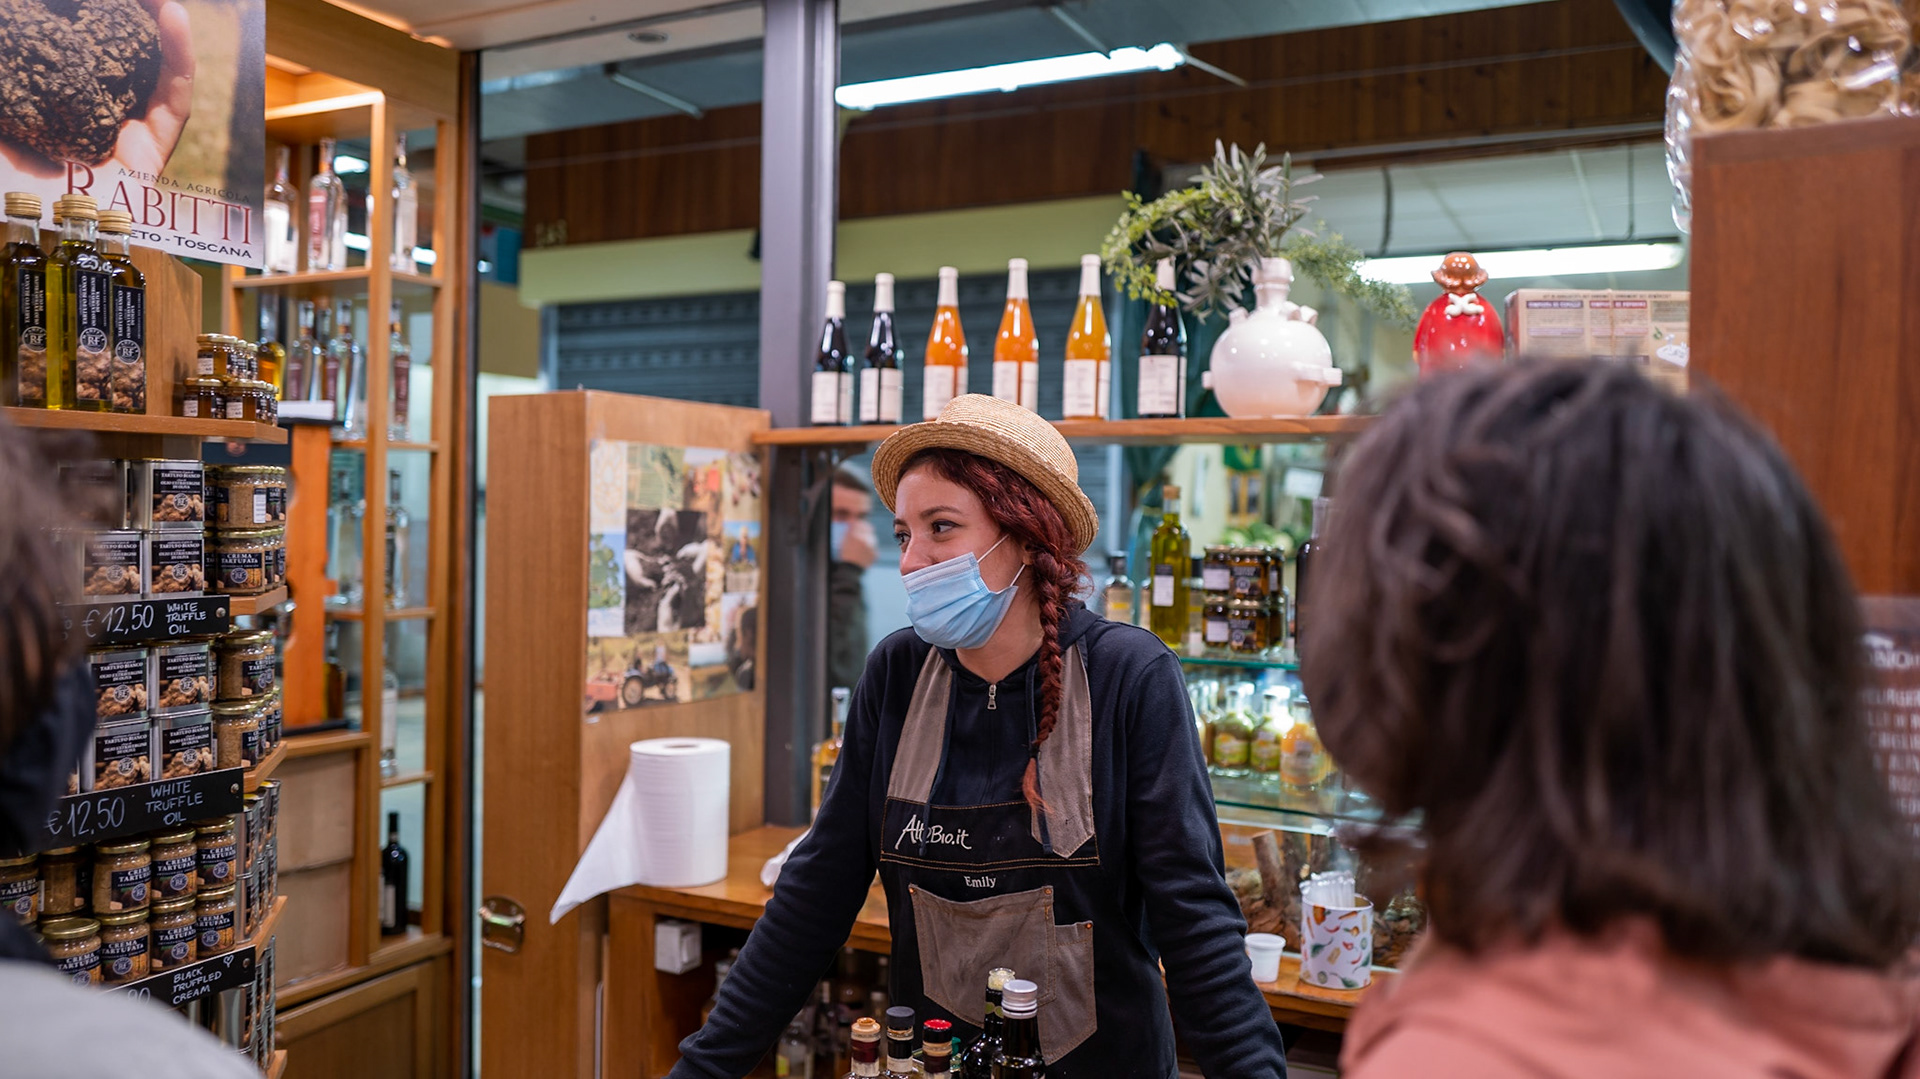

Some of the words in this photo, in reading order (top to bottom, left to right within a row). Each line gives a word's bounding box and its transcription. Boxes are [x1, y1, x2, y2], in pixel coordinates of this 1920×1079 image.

[118, 168, 179, 188] AZIENDA
[187, 183, 250, 202] AGRICOLA
[174, 236, 252, 258] TOSCANA
[167, 602, 198, 612] WHITE
[165, 611, 207, 623] TRUFFLE
[168, 623, 190, 635] OIL
[151, 780, 191, 798] WHITE
[145, 792, 203, 813] TRUFFLE
[164, 812, 186, 826] OIL
[964, 876, 996, 889] Emily
[109, 940, 137, 948] CREMA
[173, 971, 222, 993] TRUFFLED
[174, 966, 204, 984] BLACK
[173, 984, 210, 1005] CREAM
